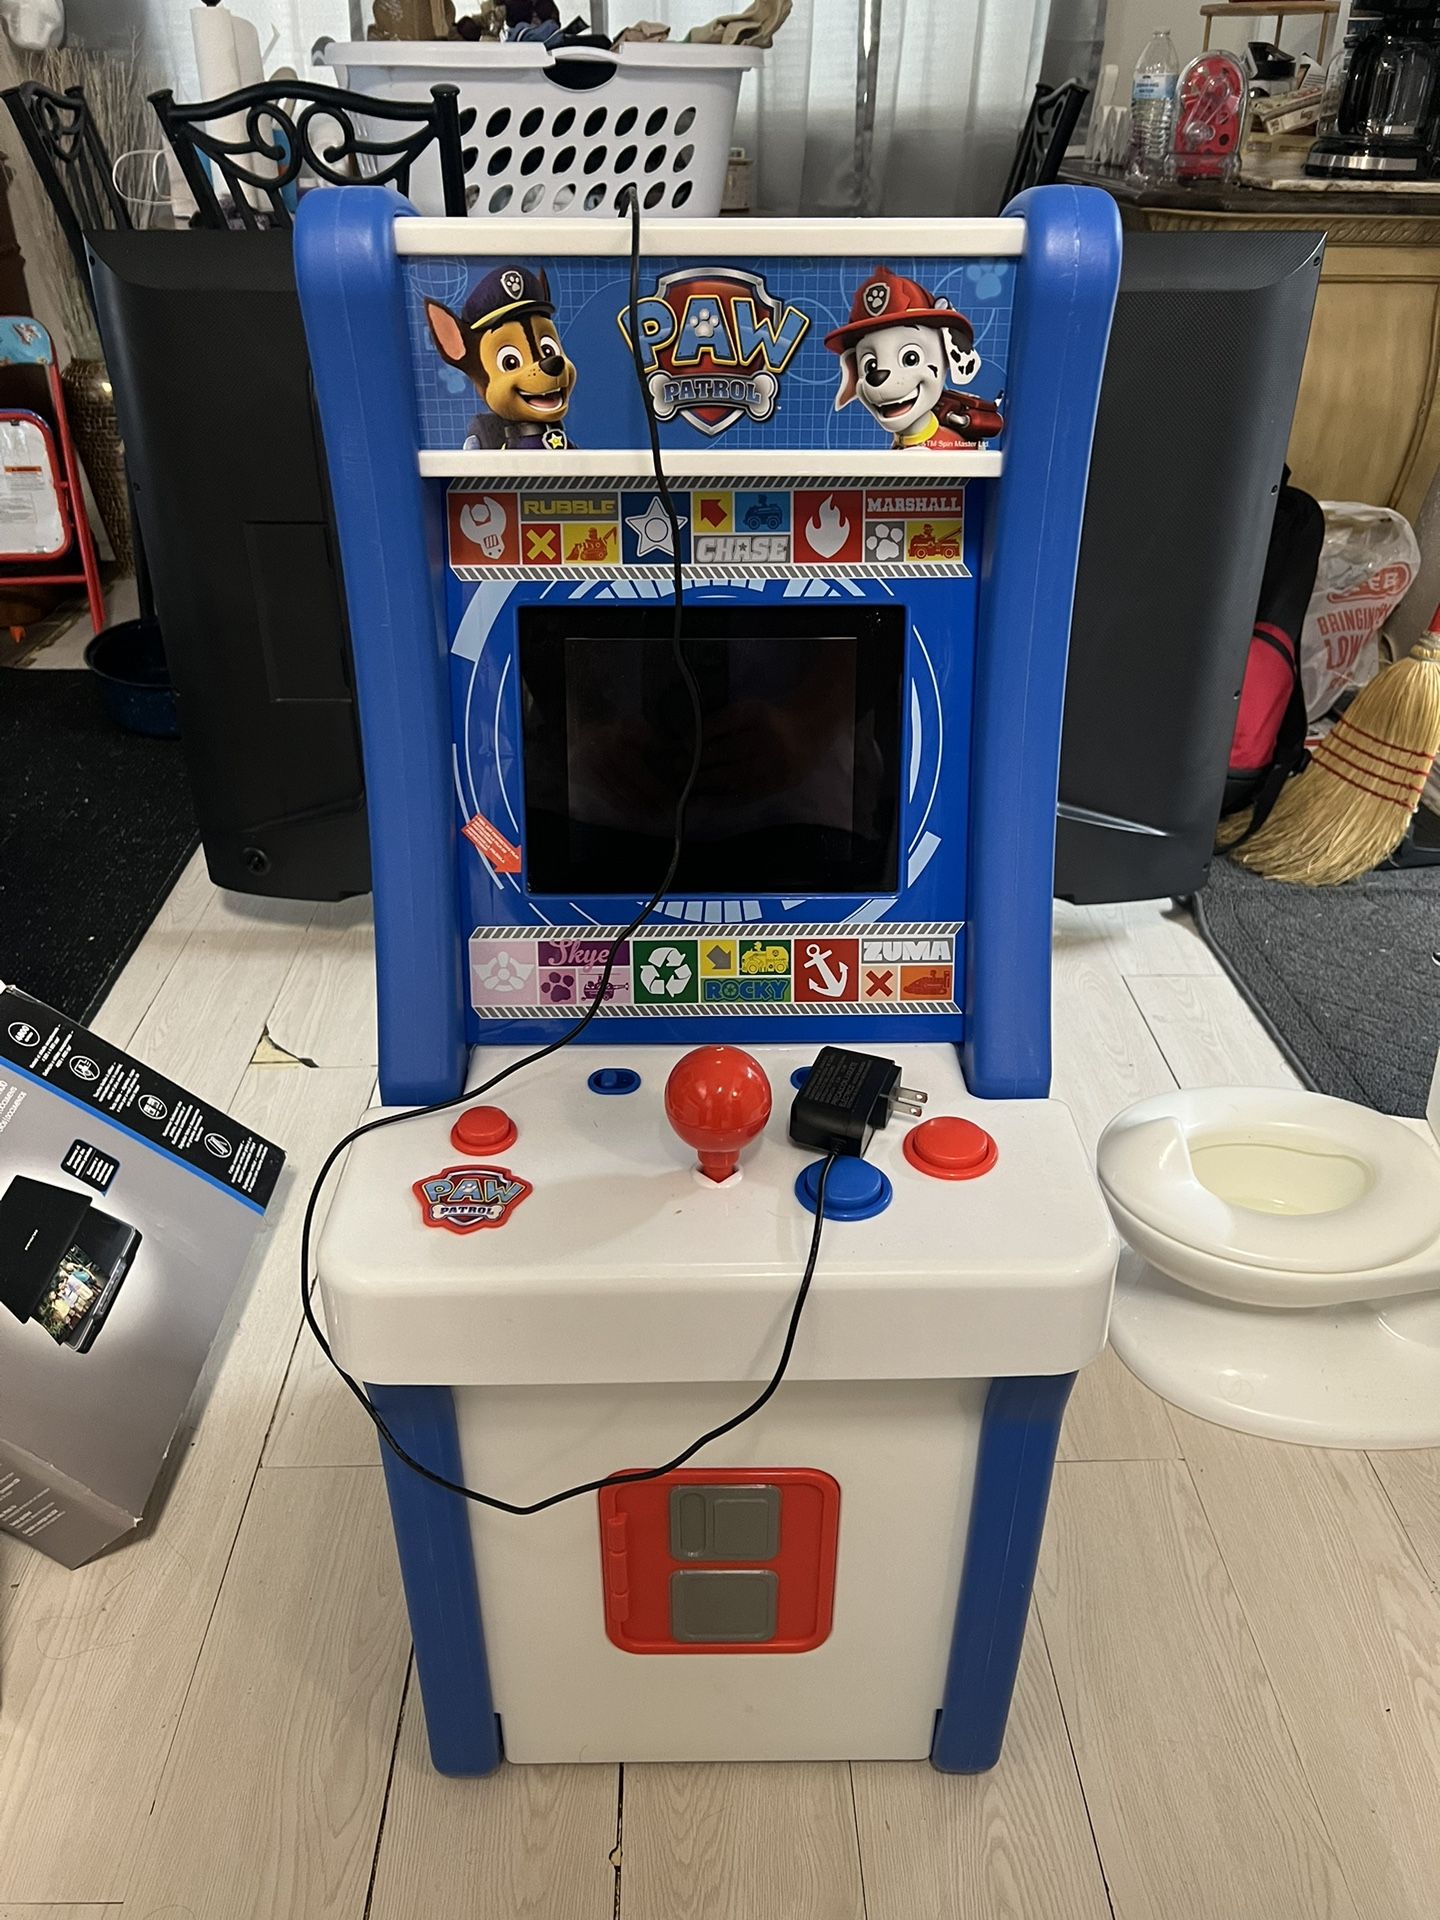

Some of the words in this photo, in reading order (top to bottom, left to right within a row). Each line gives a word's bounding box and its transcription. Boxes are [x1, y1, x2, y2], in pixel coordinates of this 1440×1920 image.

[617, 294, 810, 374] PAW
[663, 379, 762, 405] PATROL
[954, 440, 977, 448] Master
[523, 499, 616, 516] RUBBLE
[867, 497, 961, 512] MARSHALL
[696, 537, 789, 563] CHASE
[547, 938, 611, 973] Skye
[863, 941, 951, 961] ZUMA
[706, 980, 789, 1000] ROCKY
[422, 1178, 526, 1204] PAW
[440, 1206, 495, 1216] PATROL
